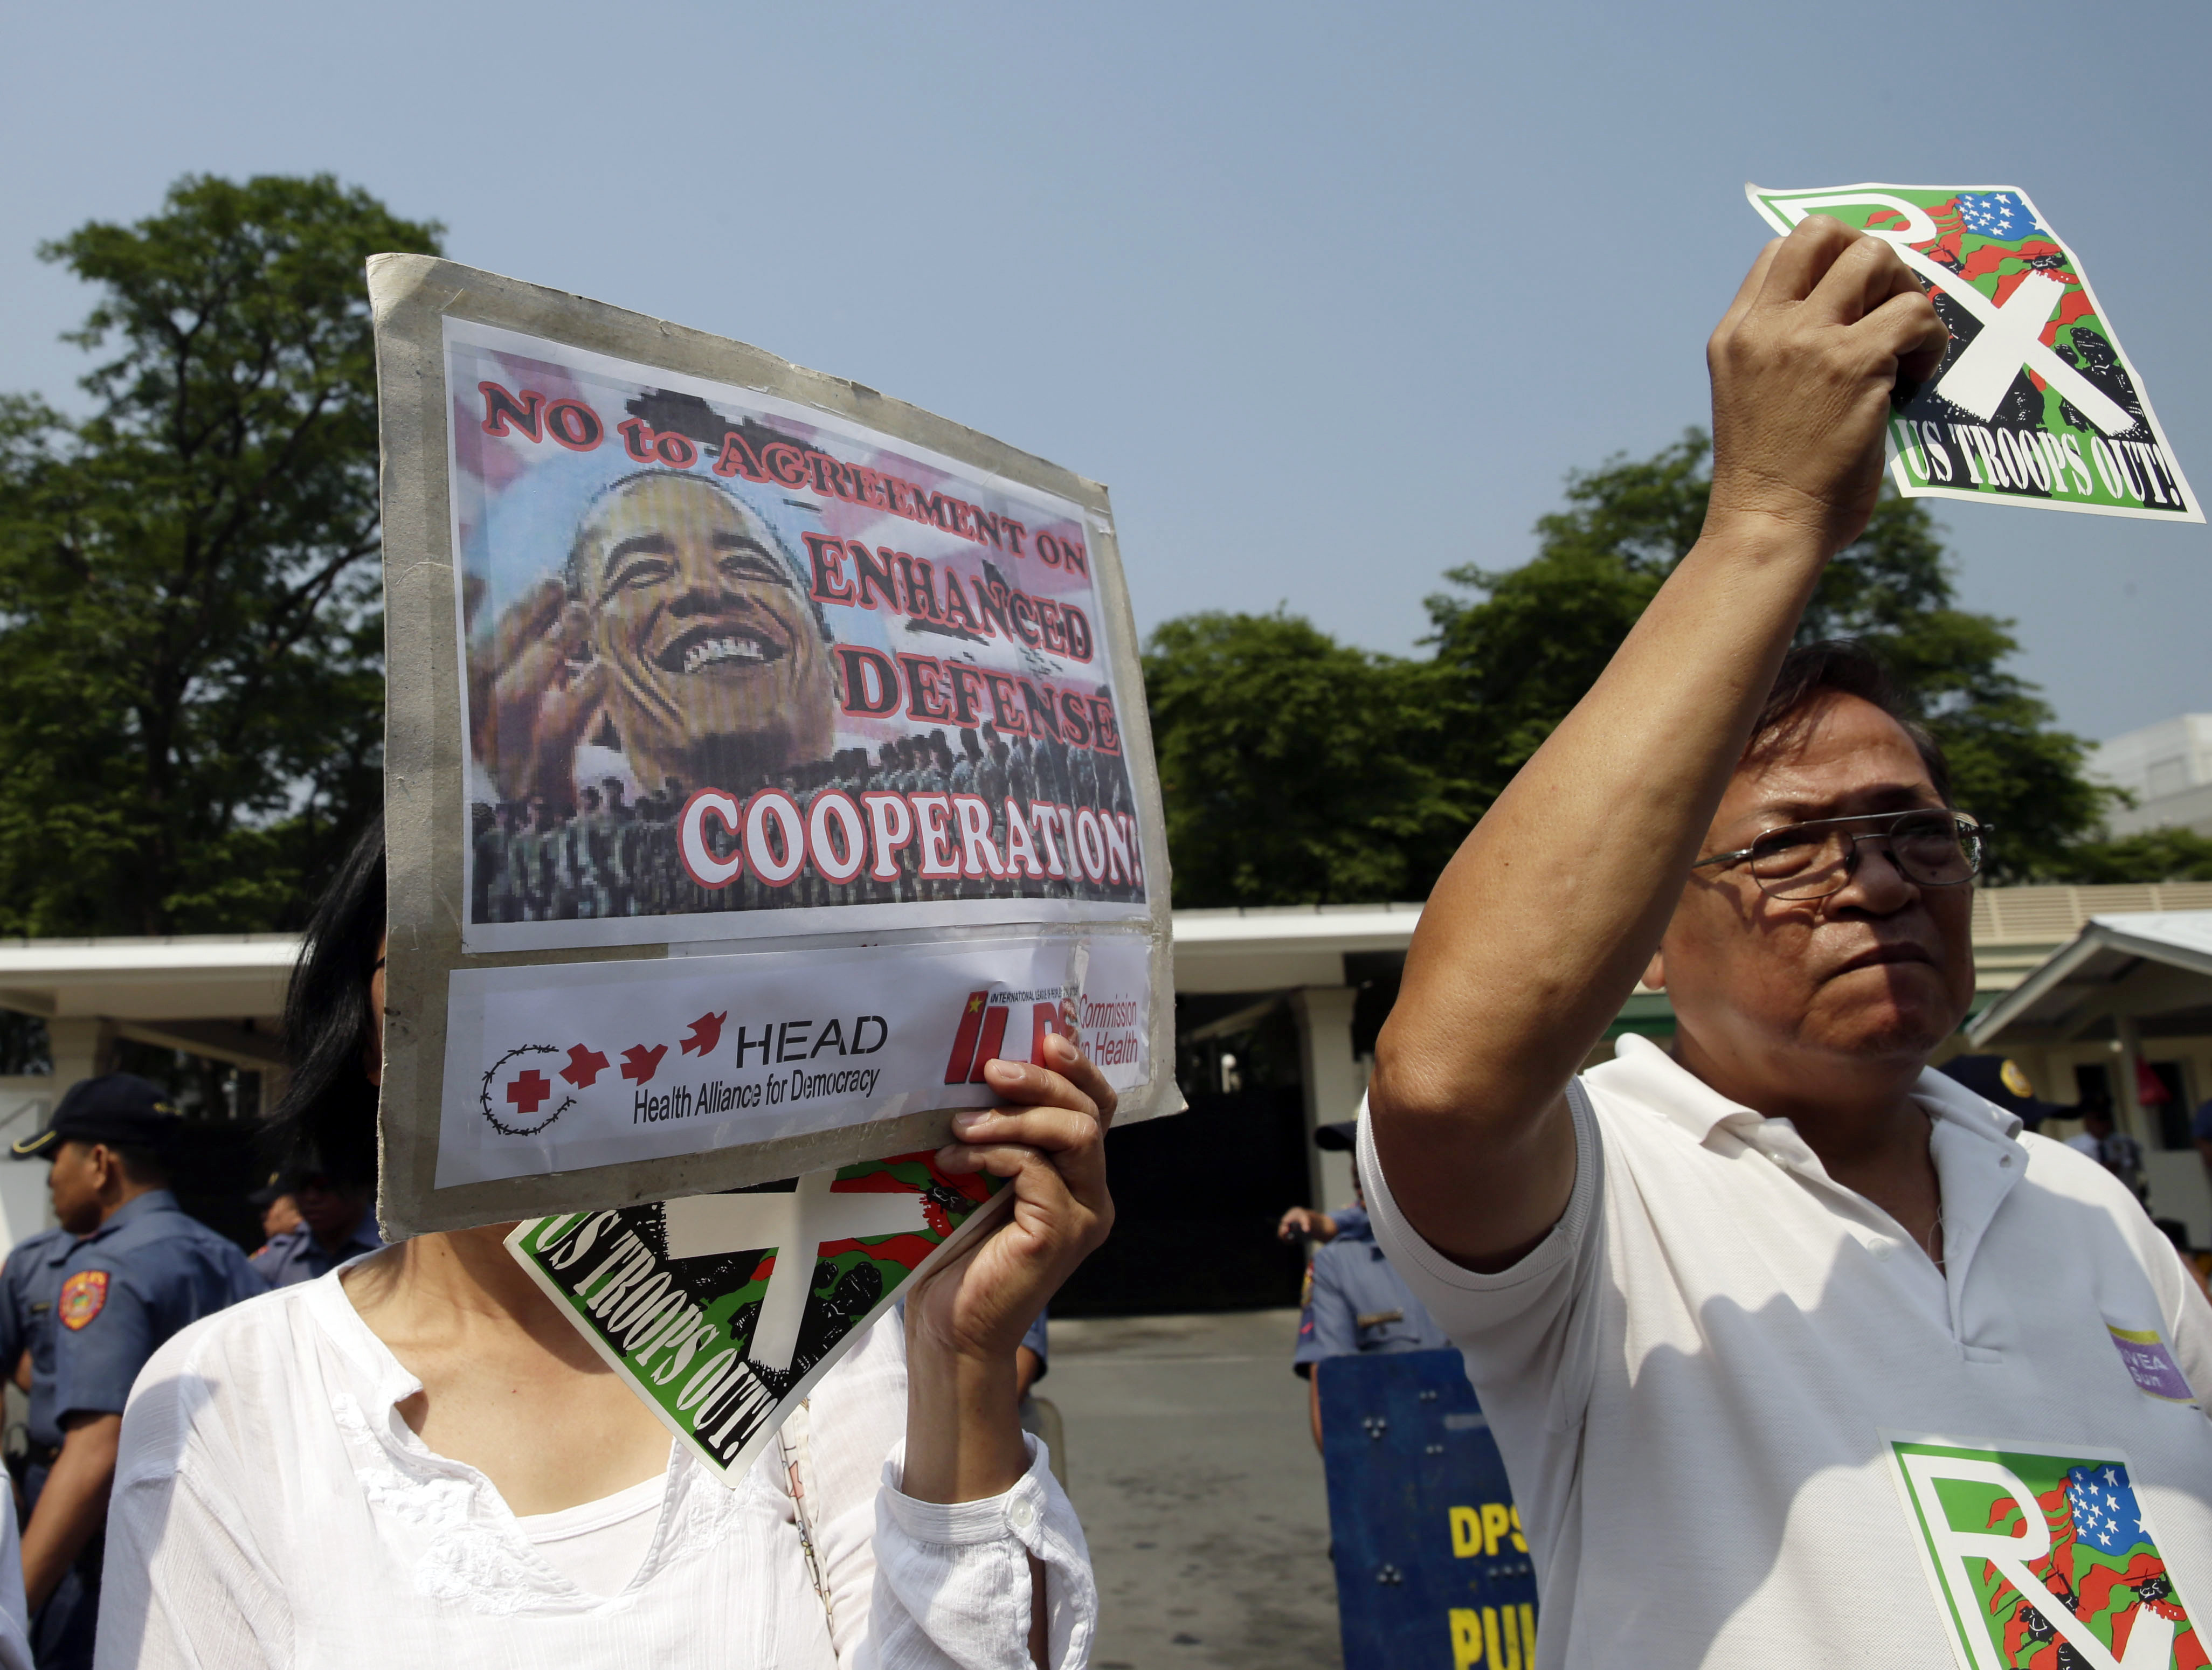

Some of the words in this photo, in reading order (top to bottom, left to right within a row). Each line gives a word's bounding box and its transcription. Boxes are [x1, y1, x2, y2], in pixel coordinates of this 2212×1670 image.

[478, 380, 604, 452] NO
[618, 413, 697, 468] to
[713, 431, 1027, 561] AGREEMENT
[1035, 529, 1088, 579] ON
[1894, 419, 1953, 482] US
[1948, 423, 2094, 496] TROOPS
[2090, 436, 2181, 507] OUT!
[801, 530, 1093, 664] ENHANCED
[832, 644, 1121, 755] DEFENSE
[676, 787, 1144, 890] COOPERATION!
[990, 990, 1035, 1003] INTERNATIONAL
[1079, 993, 1137, 1029] Commission
[736, 1015, 889, 1069] HEAD
[1095, 1030, 1138, 1066] Health
[633, 1085, 692, 1124] Health
[694, 1080, 762, 1116] Alliance
[765, 1073, 788, 1105] for
[790, 1069, 881, 1101] Democracy
[535, 1209, 622, 1270] US
[573, 1229, 719, 1385] TROOPS
[676, 1348, 778, 1460] OUT!
